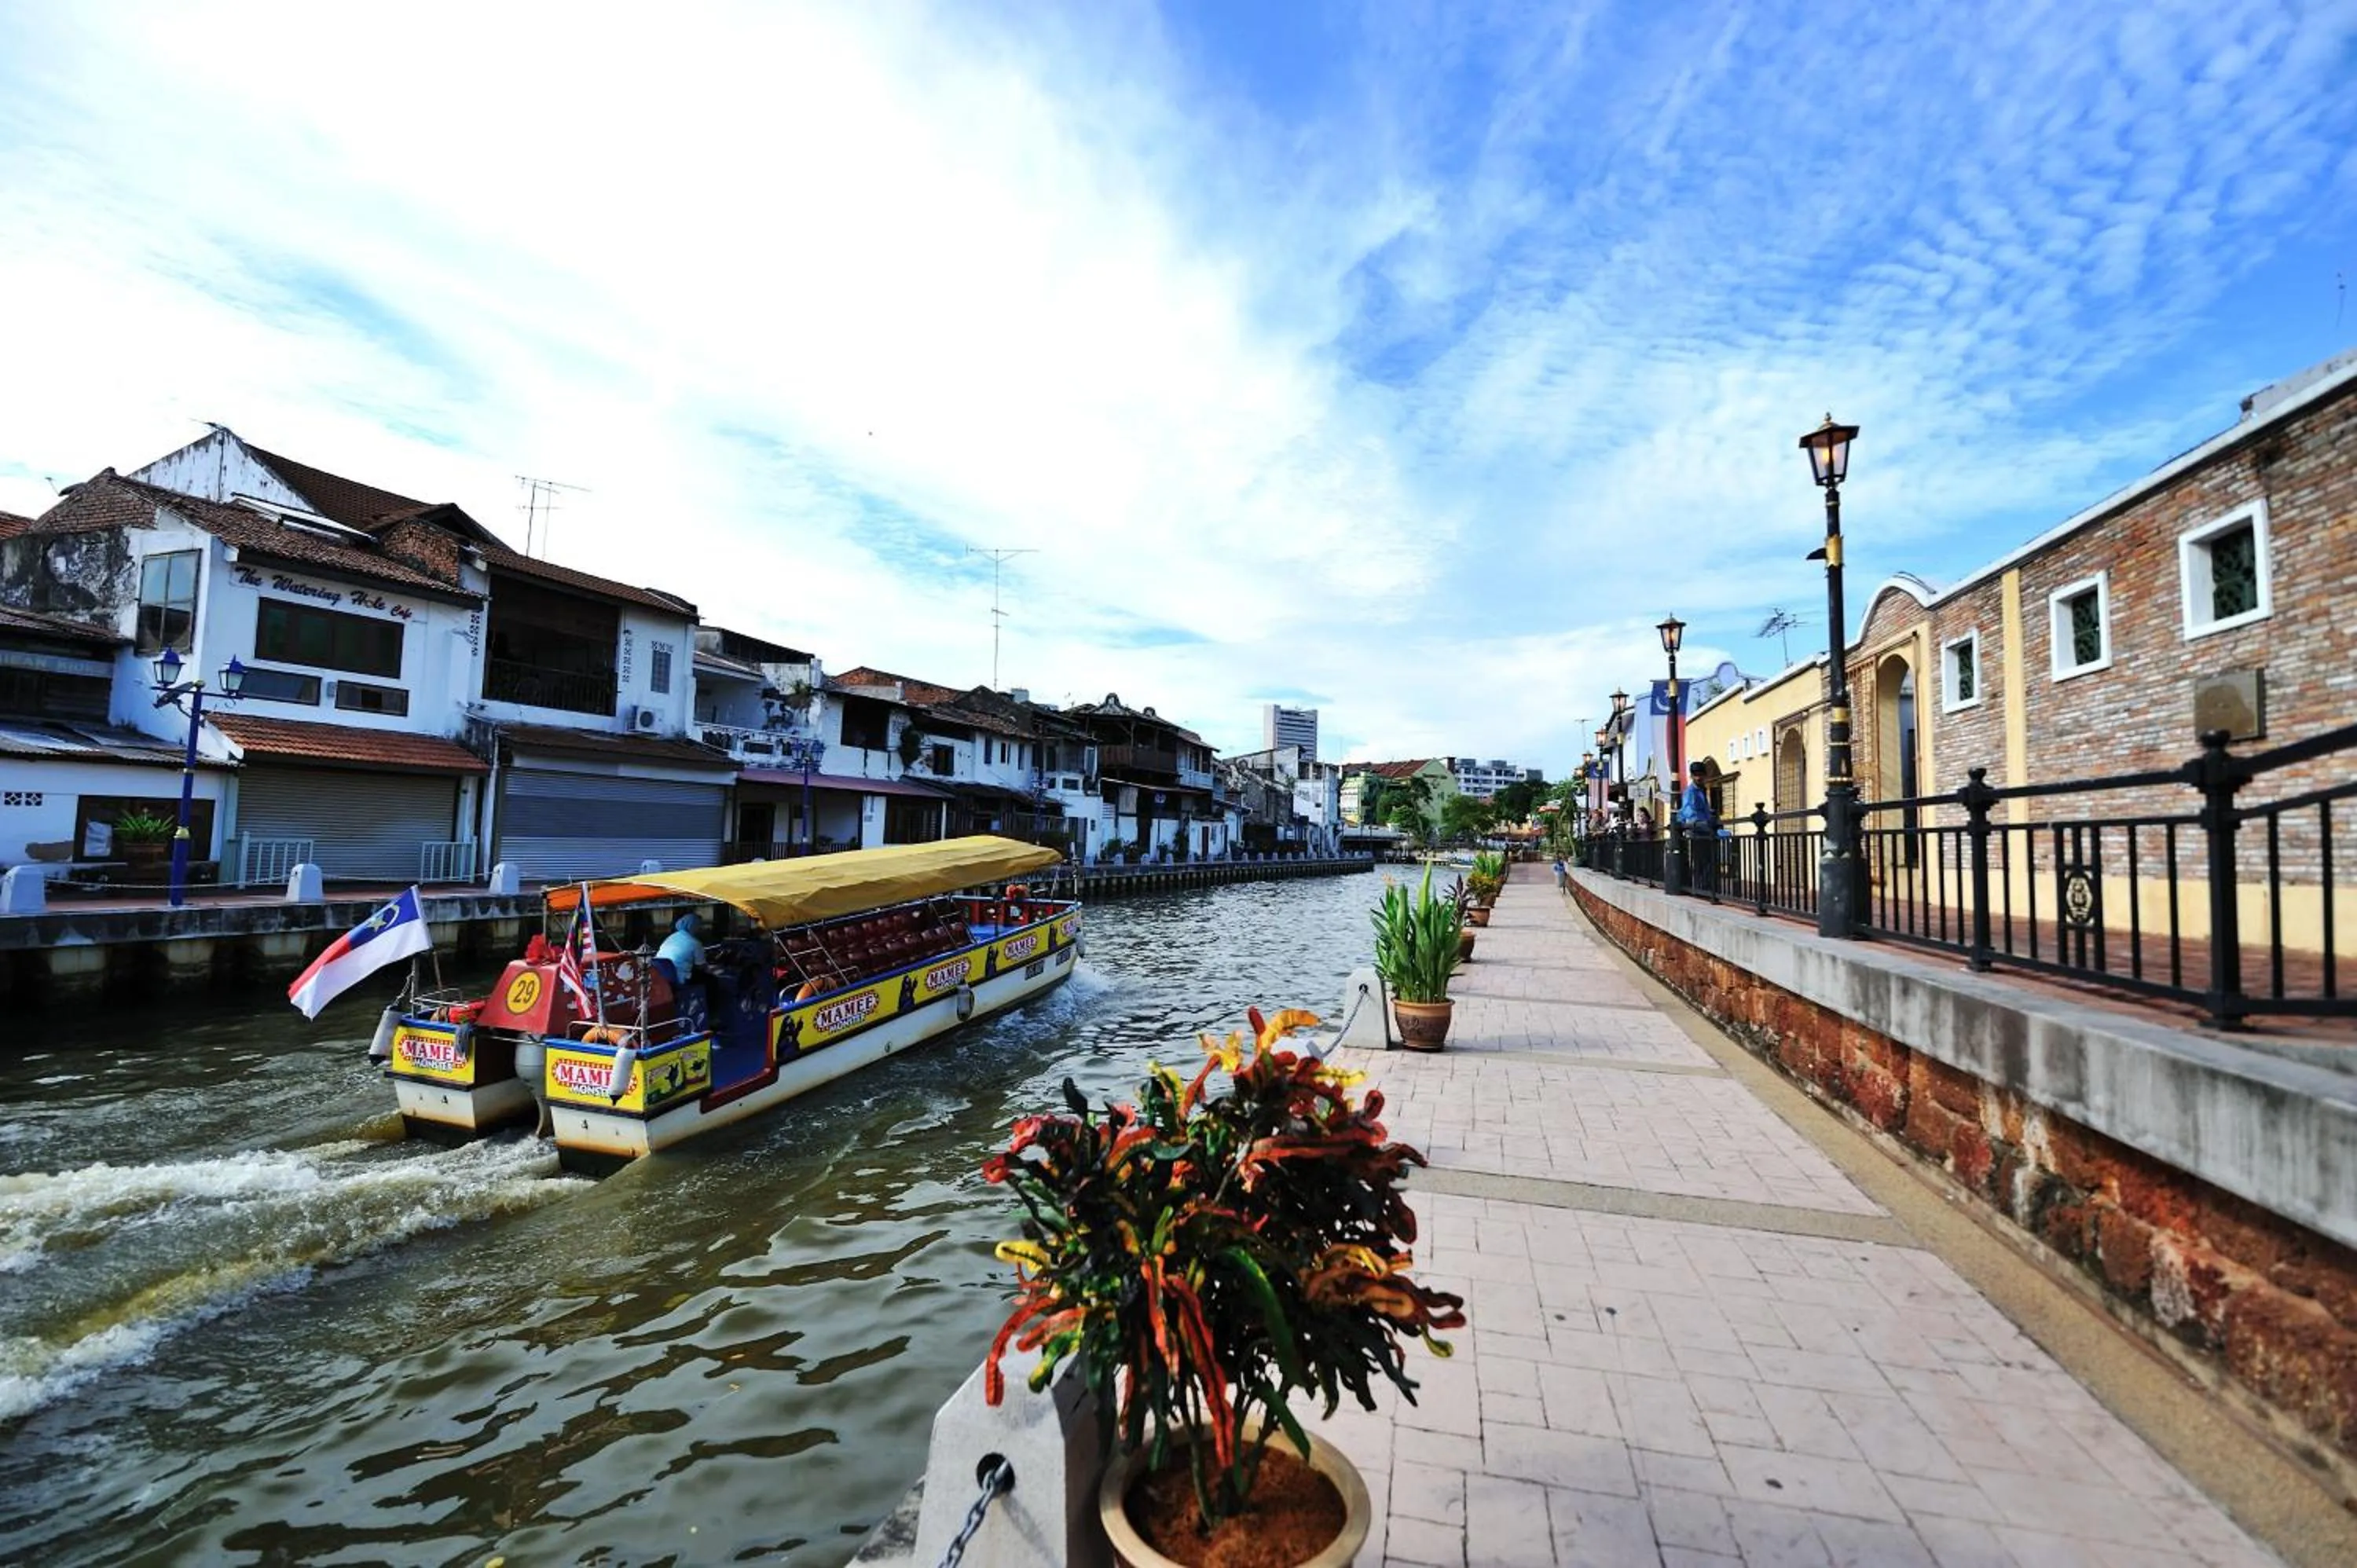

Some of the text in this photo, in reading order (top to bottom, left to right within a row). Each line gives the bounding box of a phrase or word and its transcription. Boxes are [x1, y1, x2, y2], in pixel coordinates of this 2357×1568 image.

[235, 564, 264, 587] The
[272, 574, 341, 606] Watering
[350, 590, 387, 611] Hole
[513, 980, 535, 1004] 29
[819, 994, 874, 1027] MAMEE
